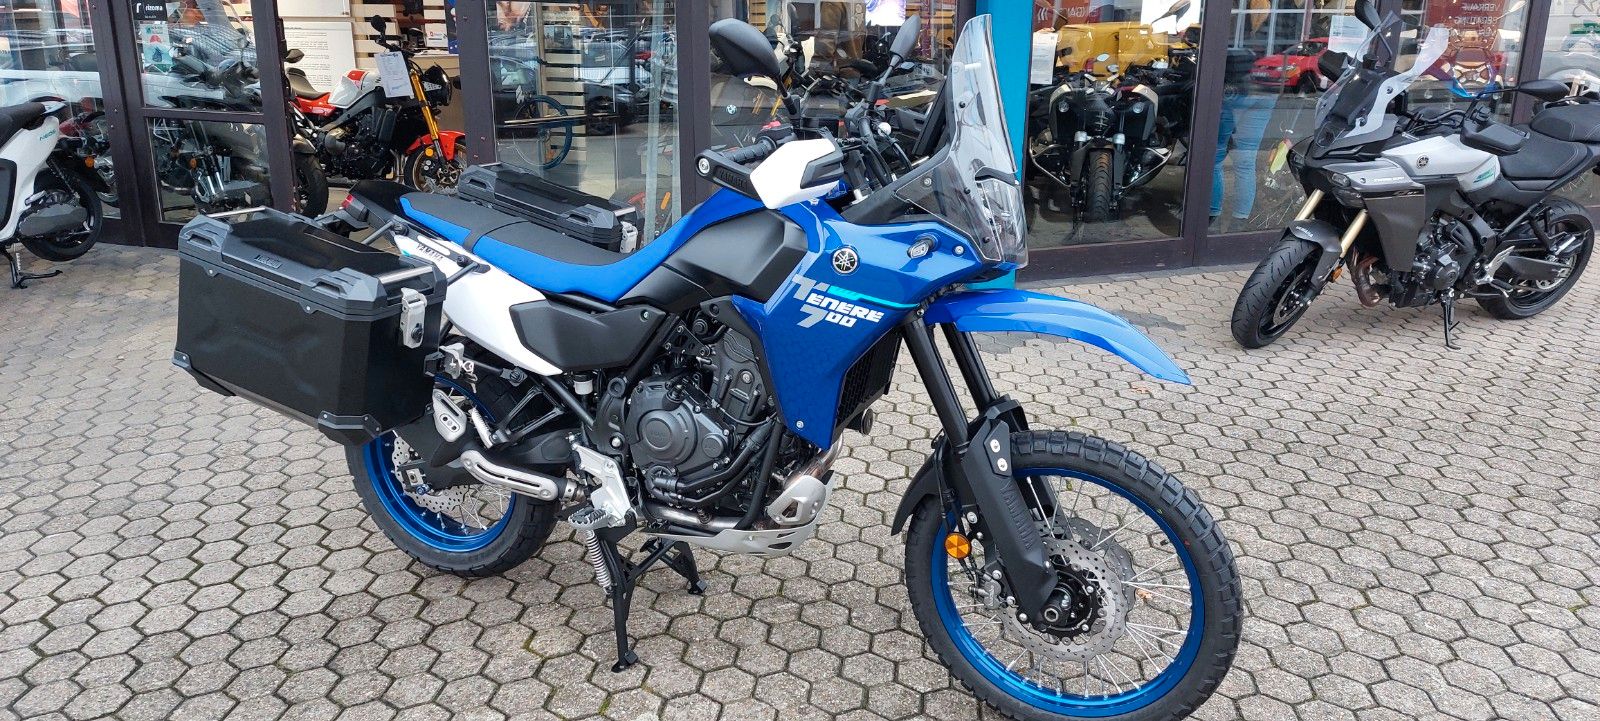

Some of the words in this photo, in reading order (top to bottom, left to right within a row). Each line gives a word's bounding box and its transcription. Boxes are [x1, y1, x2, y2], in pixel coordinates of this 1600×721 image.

[416, 243, 444, 262] YAMAHA
[797, 304, 857, 328] 700
[1000, 478, 1037, 553] YAMAHA
